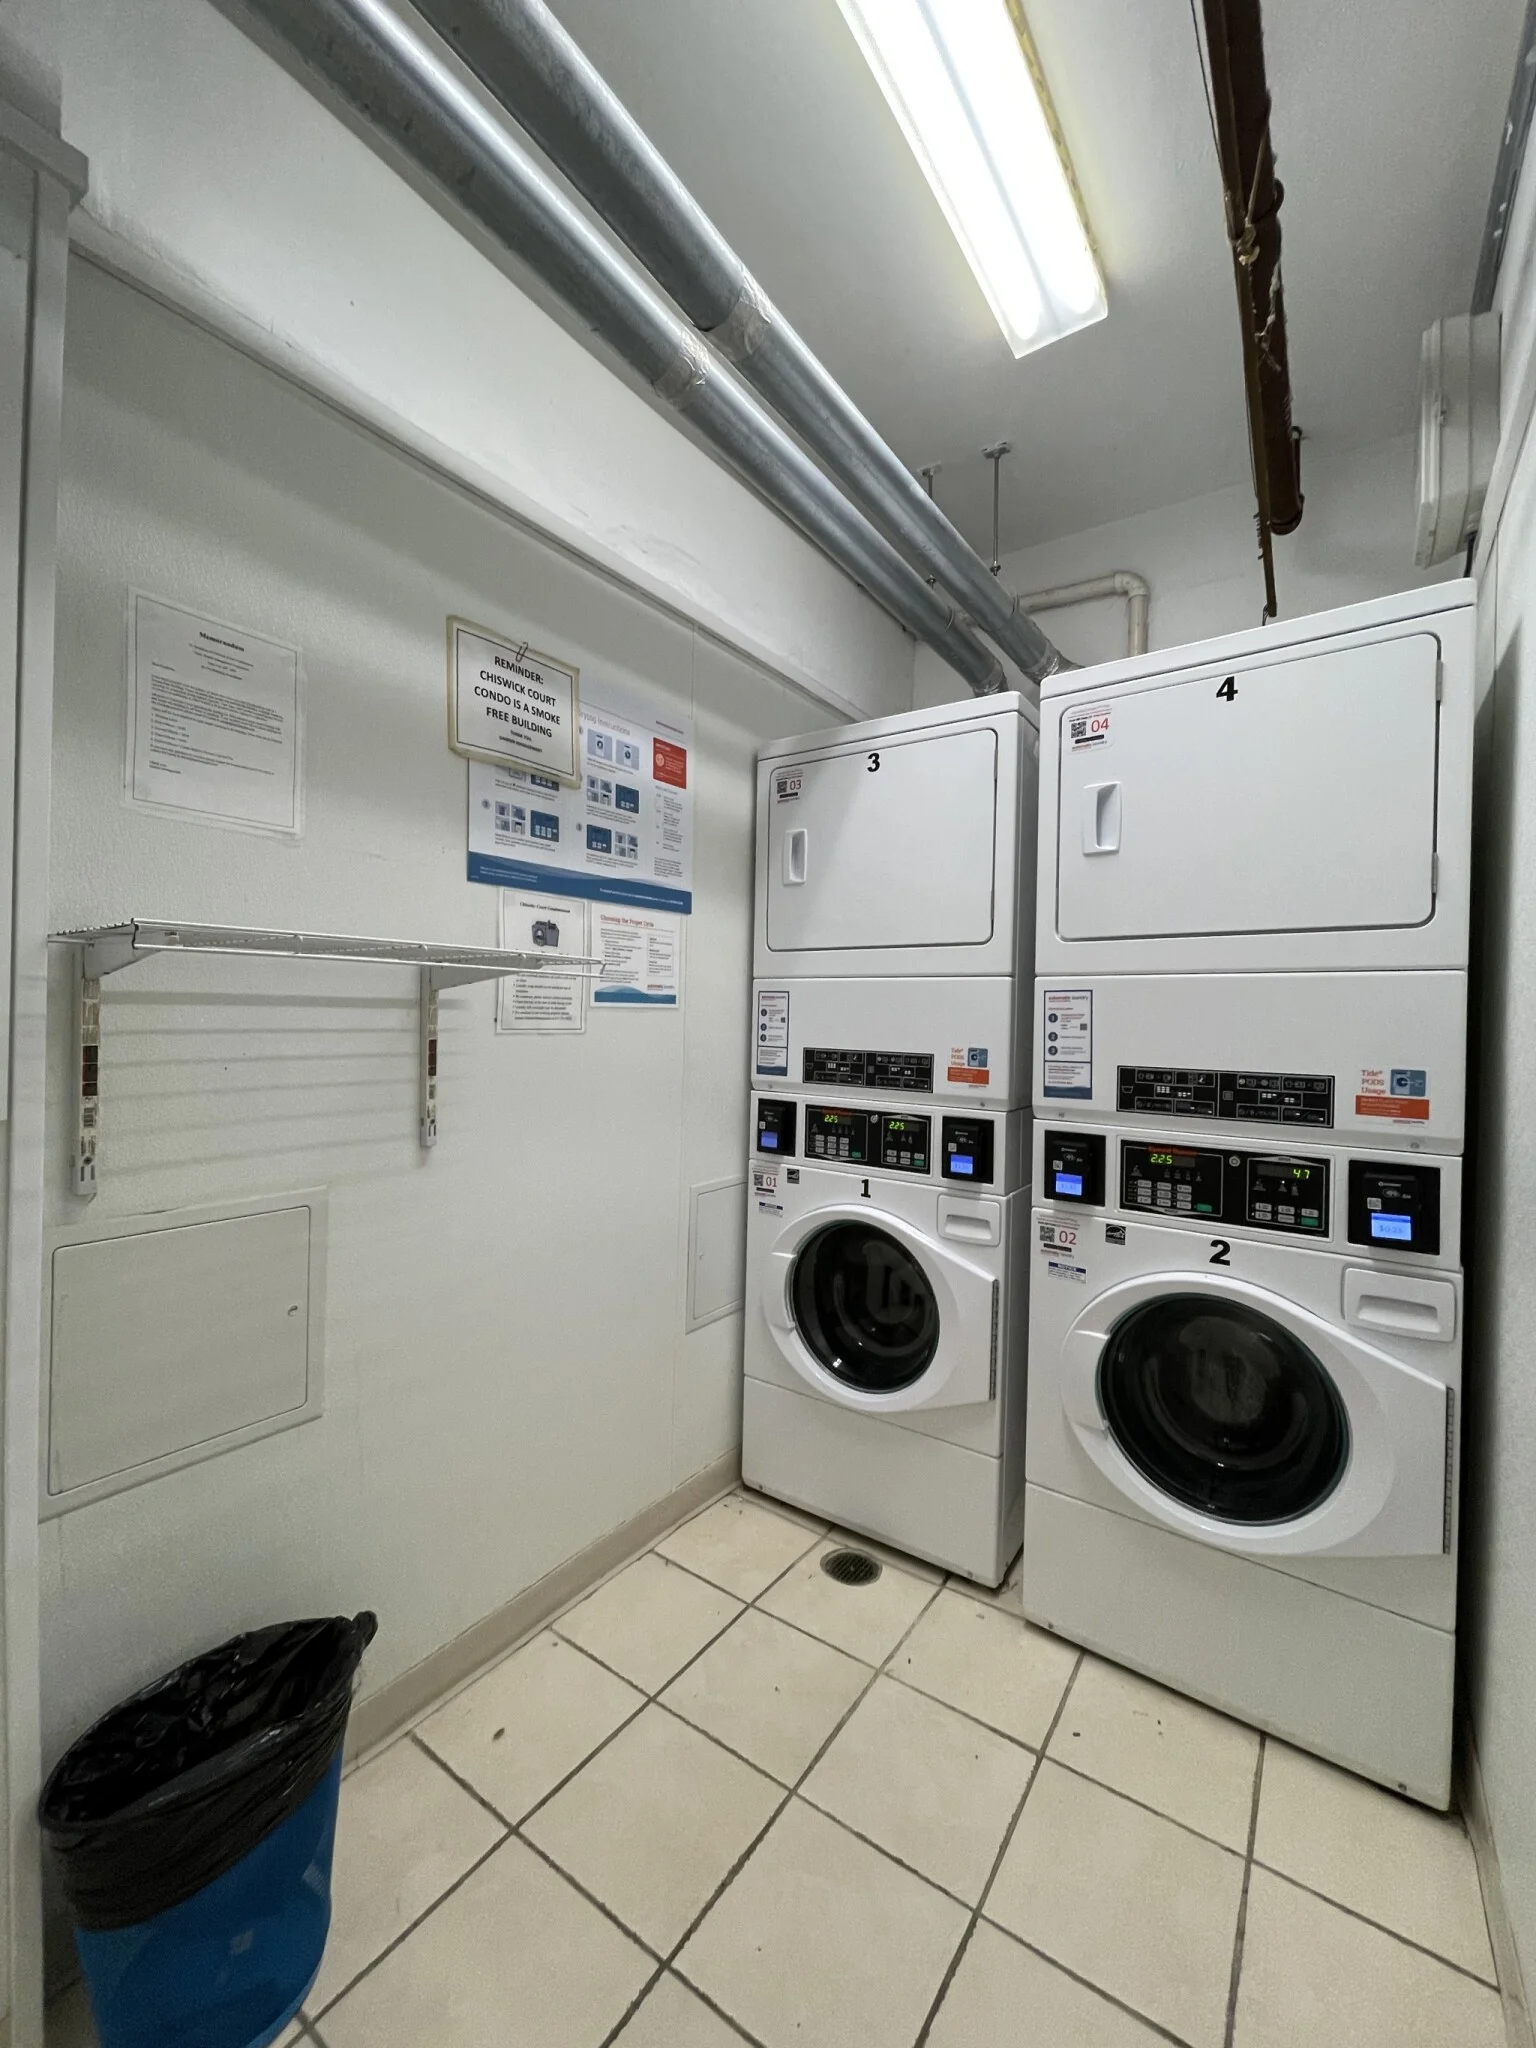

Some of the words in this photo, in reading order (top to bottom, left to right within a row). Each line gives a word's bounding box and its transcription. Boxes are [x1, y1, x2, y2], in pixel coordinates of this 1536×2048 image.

[494, 656, 544, 685] REMINDER:
[480, 670, 526, 696] CHISWICK
[528, 688, 556, 707] COURT
[1216, 676, 1238, 702] 4
[474, 686, 511, 706] CONDO
[513, 698, 521, 710] IS
[523, 703, 530, 714] A
[531, 707, 561, 726] SMOKE
[486, 706, 510, 723] FREE
[512, 715, 553, 738] BUILDING
[1091, 717, 1109, 733] 04
[867, 752, 880, 773] 3
[790, 780, 802, 790] 03
[1361, 1087, 1386, 1095] Usage
[1362, 1078, 1385, 1086] PODS
[766, 1176, 778, 1188] 01
[860, 1178, 871, 1199] 1
[1058, 1230, 1077, 1246] 02
[1209, 1240, 1231, 1266] 2
